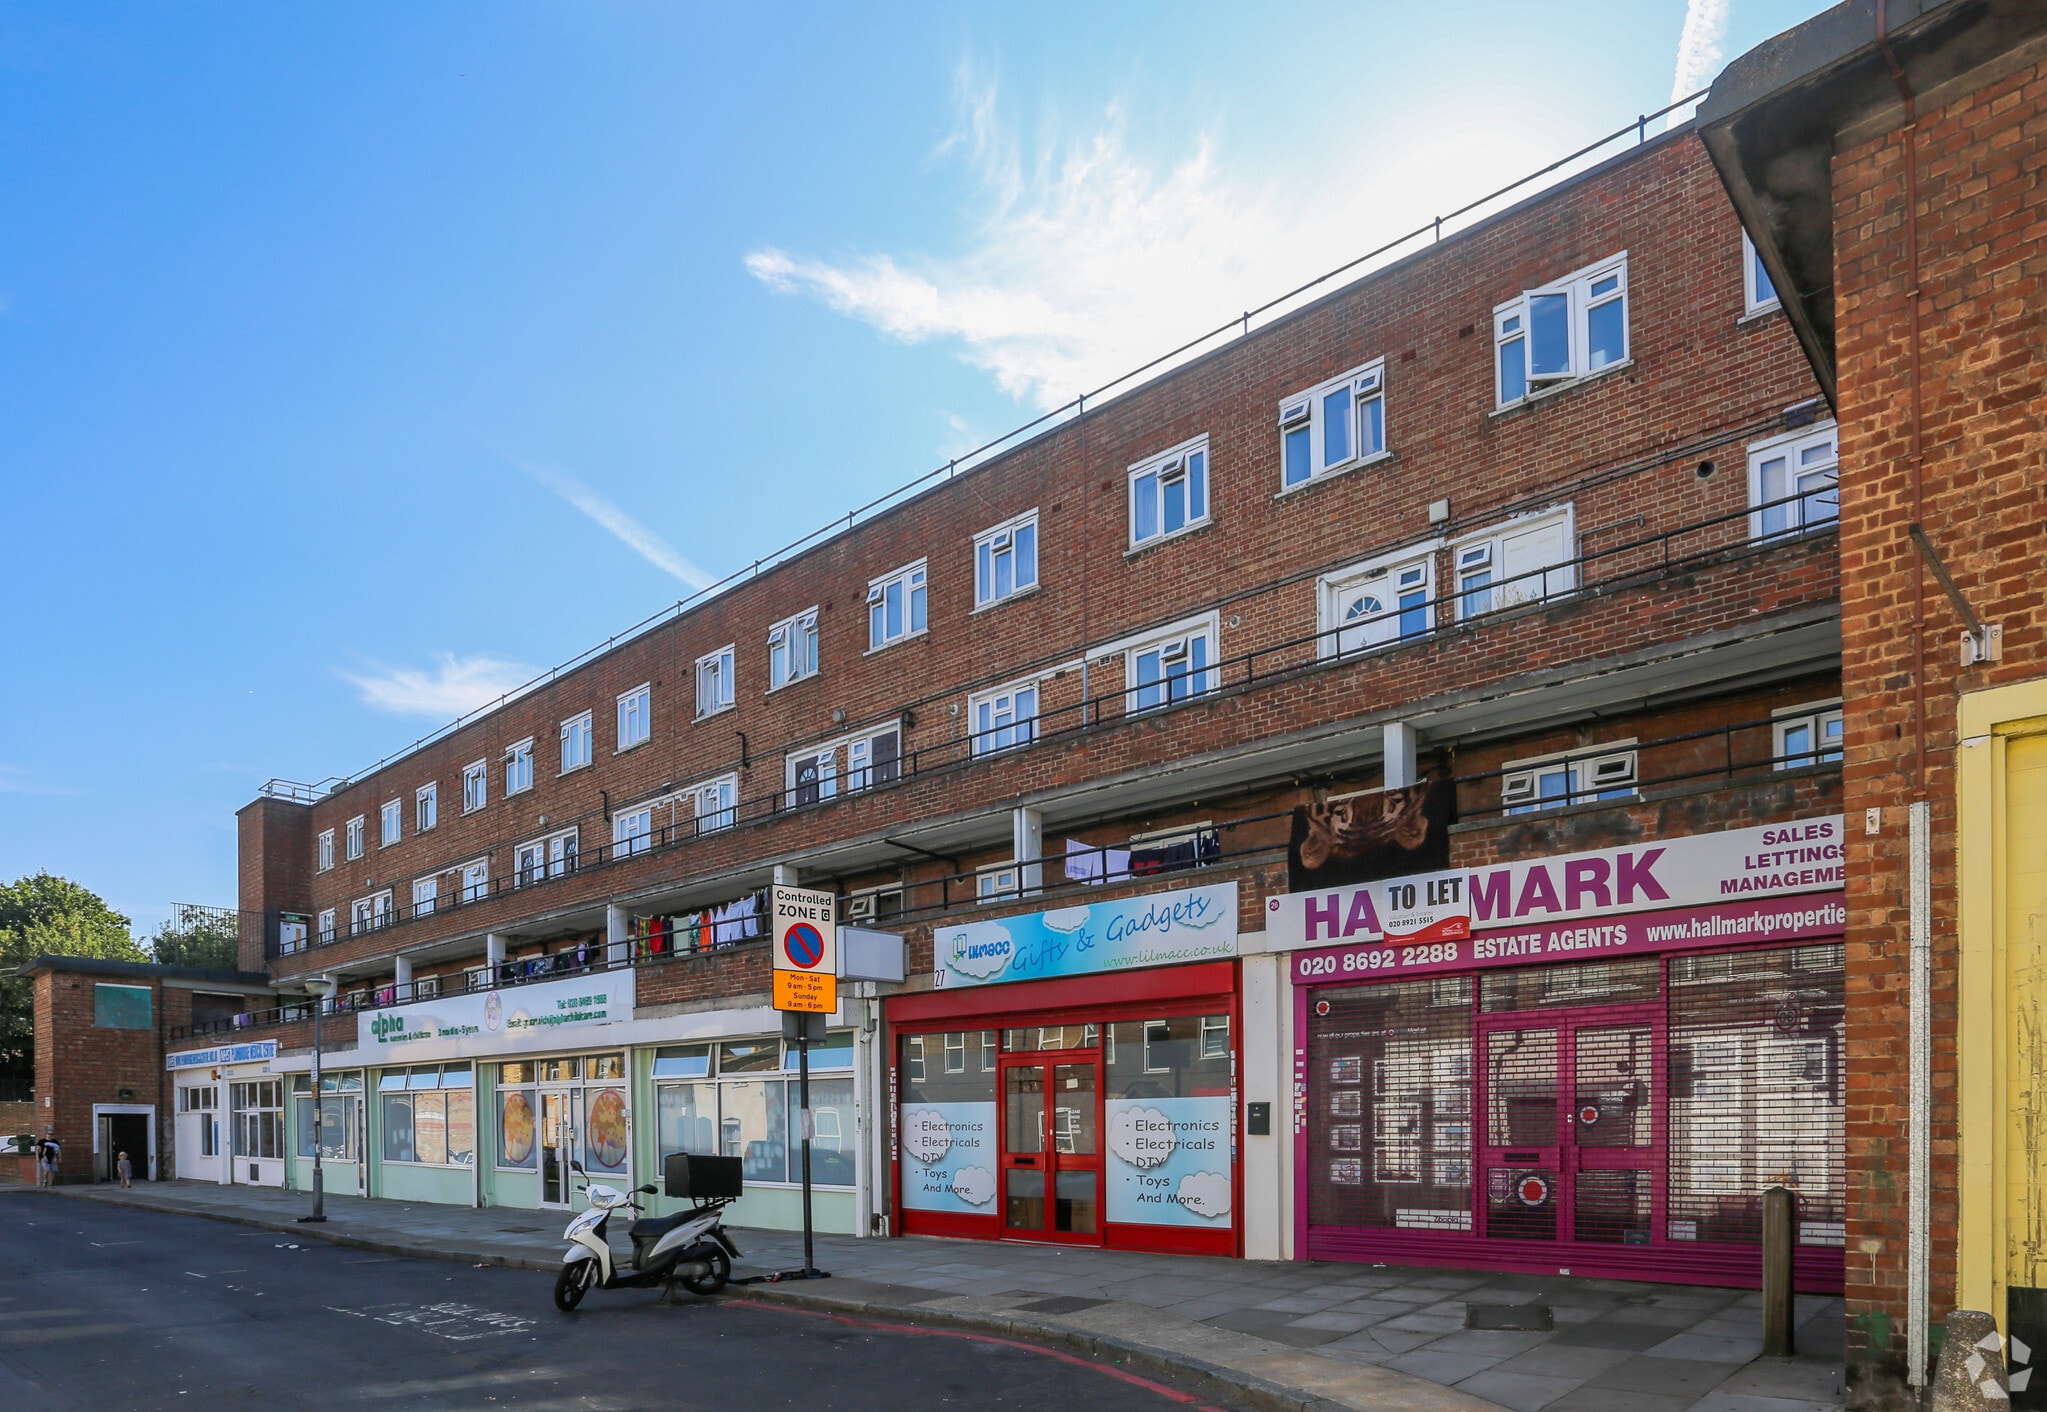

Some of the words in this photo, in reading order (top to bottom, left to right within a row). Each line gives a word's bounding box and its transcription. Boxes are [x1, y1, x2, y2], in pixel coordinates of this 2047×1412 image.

[1762, 823, 1834, 847] SALES
[777, 890, 832, 906] Controlled
[1305, 847, 1671, 941] HAMARK
[1388, 884, 1416, 911] TO
[1427, 877, 1463, 906] LET
[779, 904, 817, 919] ZONE
[822, 910, 830, 920] G
[1402, 918, 1417, 926] 8921
[1419, 916, 1434, 924] 5515
[1012, 938, 1071, 971] Gifts
[1076, 928, 1095, 953] &
[1106, 893, 1211, 942] Gadgets
[1103, 940, 1234, 967] www.lilmacc.co.uk
[1300, 956, 1337, 976] 020
[1343, 949, 1396, 972] 8692
[1402, 942, 1458, 966] 2288
[1474, 932, 1542, 959] ESTATE
[1548, 925, 1628, 951] AGENTS
[935, 969, 945, 987] 27
[793, 992, 818, 1001] Sunday
[921, 1120, 983, 1132] Electronics
[1135, 1119, 1219, 1132] Electronics
[921, 1136, 980, 1147] Electricals
[1135, 1138, 1215, 1150] Electricals
[922, 1152, 944, 1162] DIY
[1136, 1157, 1165, 1168] DIY
[922, 1168, 947, 1180] Toys
[1136, 1175, 1170, 1189] Toys
[923, 1184, 942, 1193] And
[944, 1184, 973, 1195] More.
[1137, 1193, 1162, 1203] And
[1166, 1194, 1205, 1205] More.
